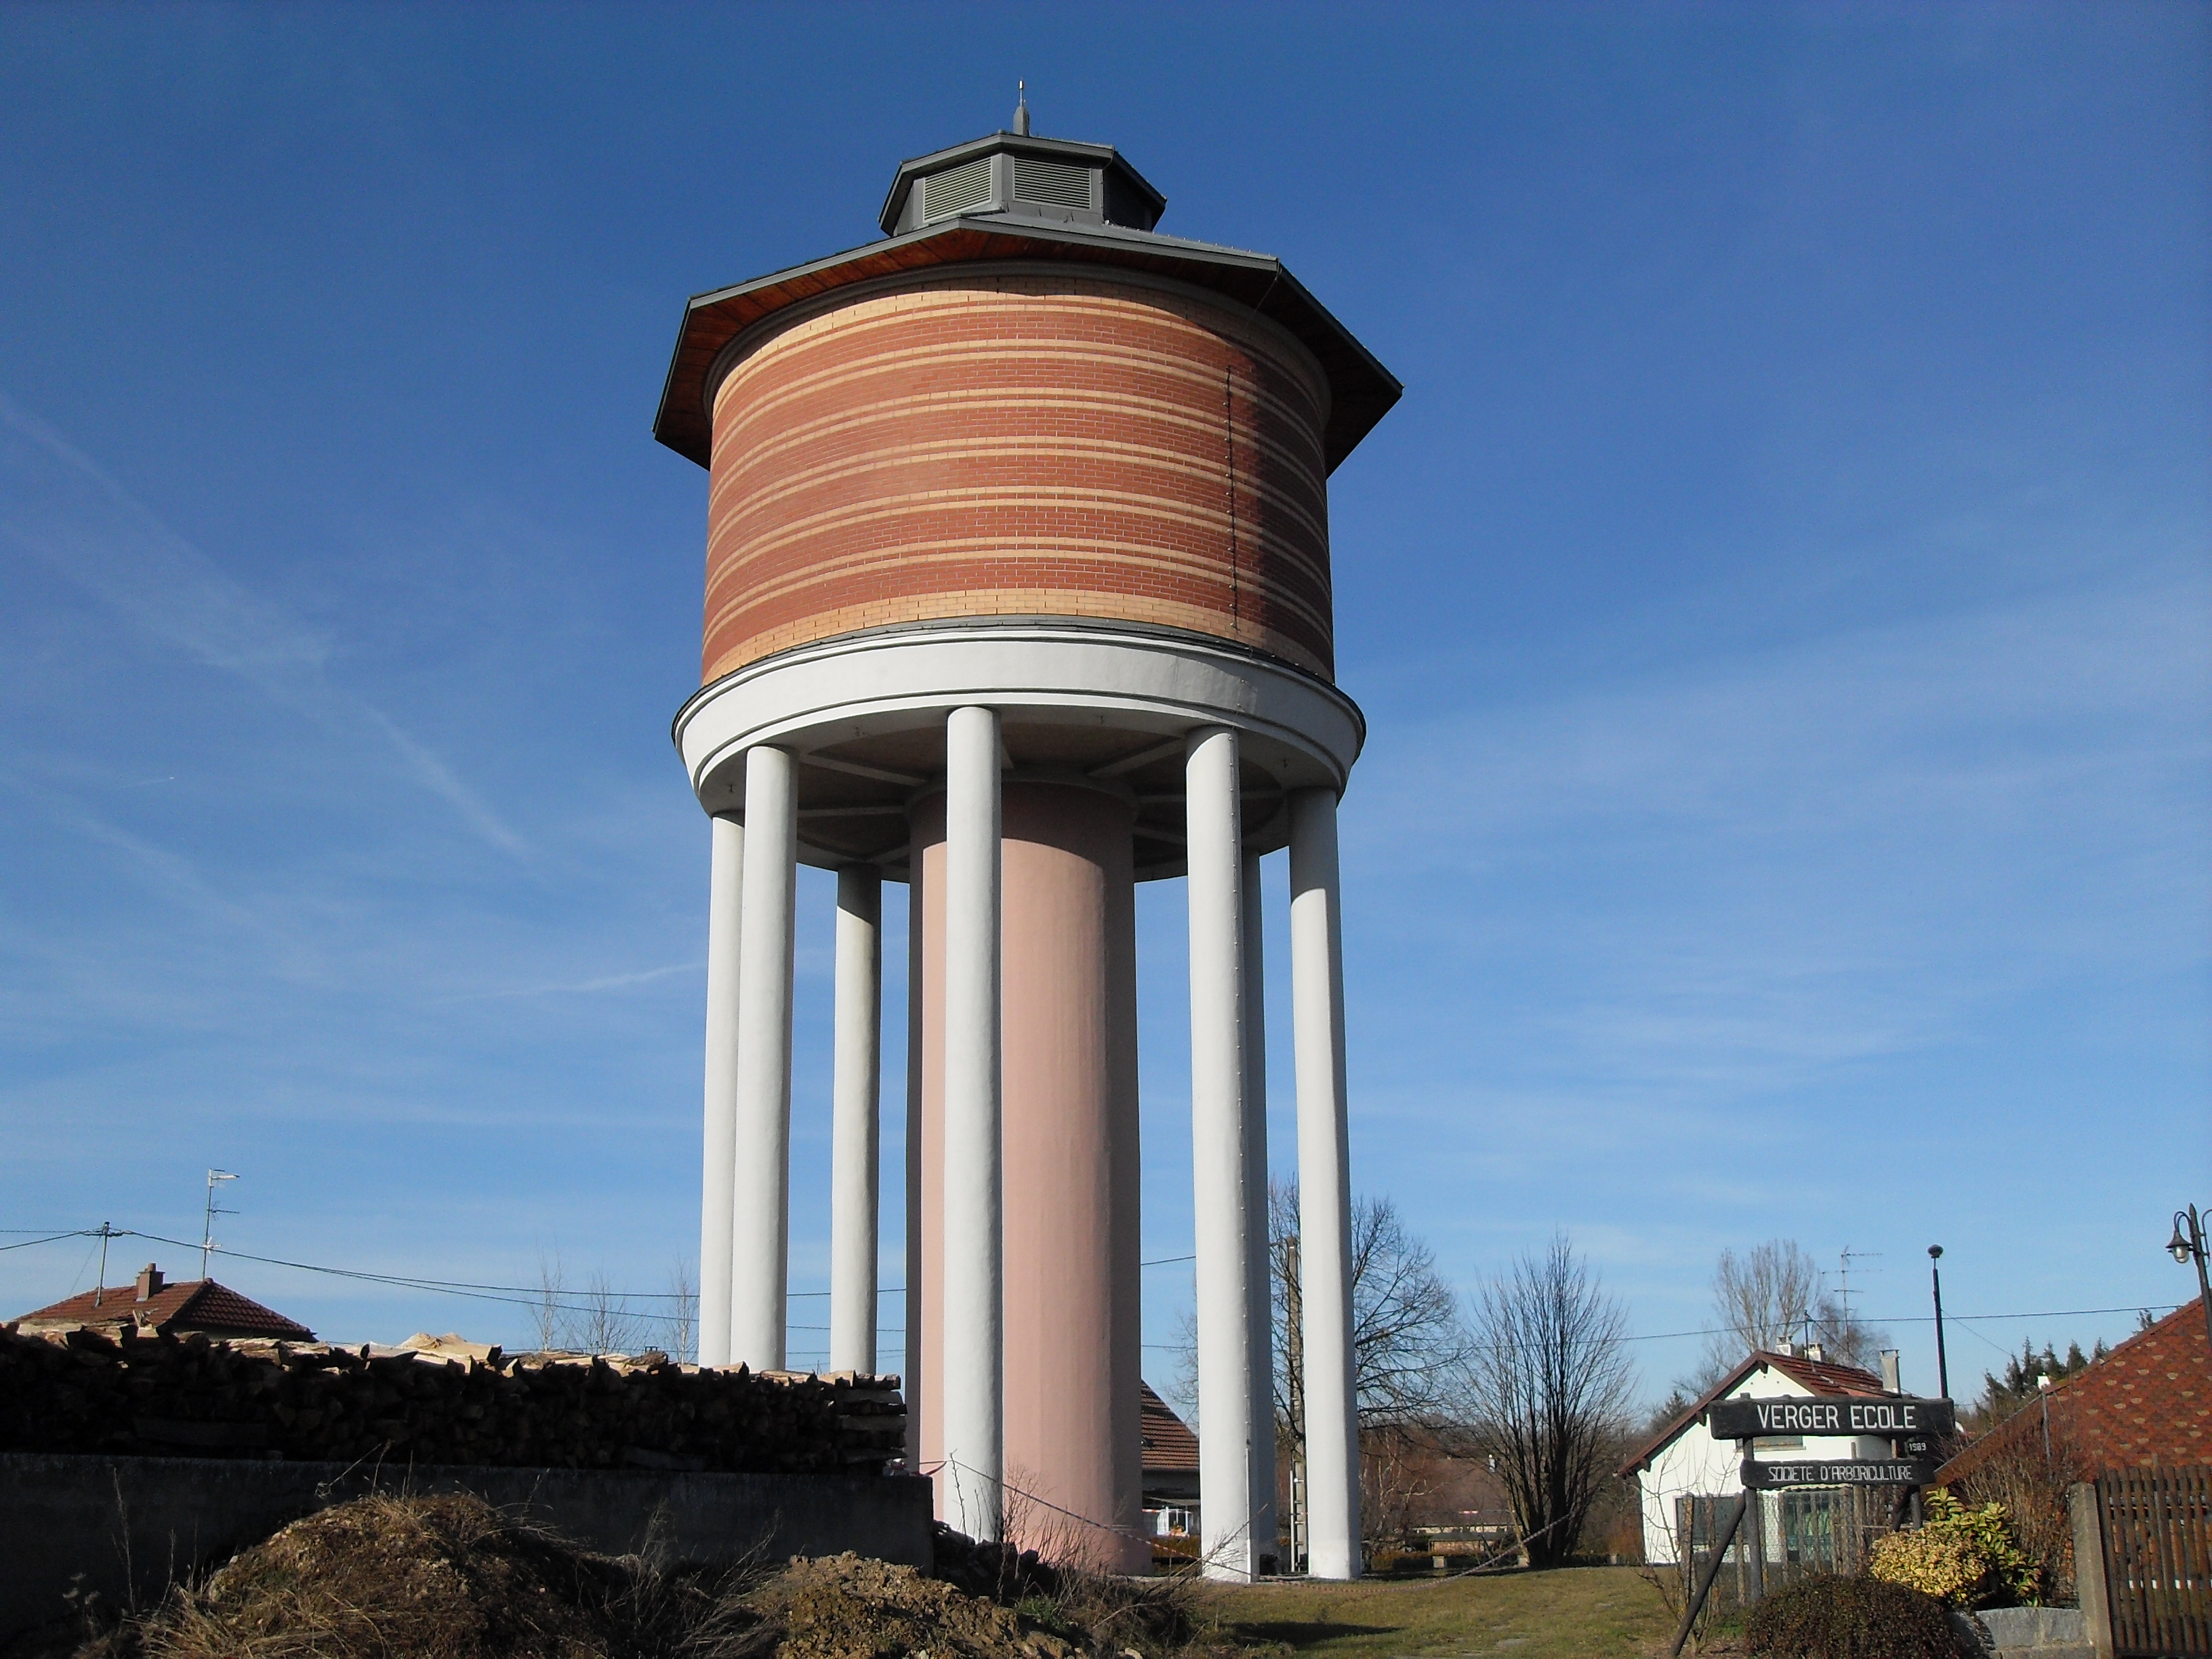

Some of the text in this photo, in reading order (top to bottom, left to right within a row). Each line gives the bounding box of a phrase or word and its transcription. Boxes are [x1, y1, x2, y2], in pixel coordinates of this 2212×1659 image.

[1757, 1404, 1917, 1429] VERGER ECOLE
[1908, 1442, 1927, 1452] 1989
[1768, 1465, 1913, 1481] SOCIETE D'ARBORICULTURE
